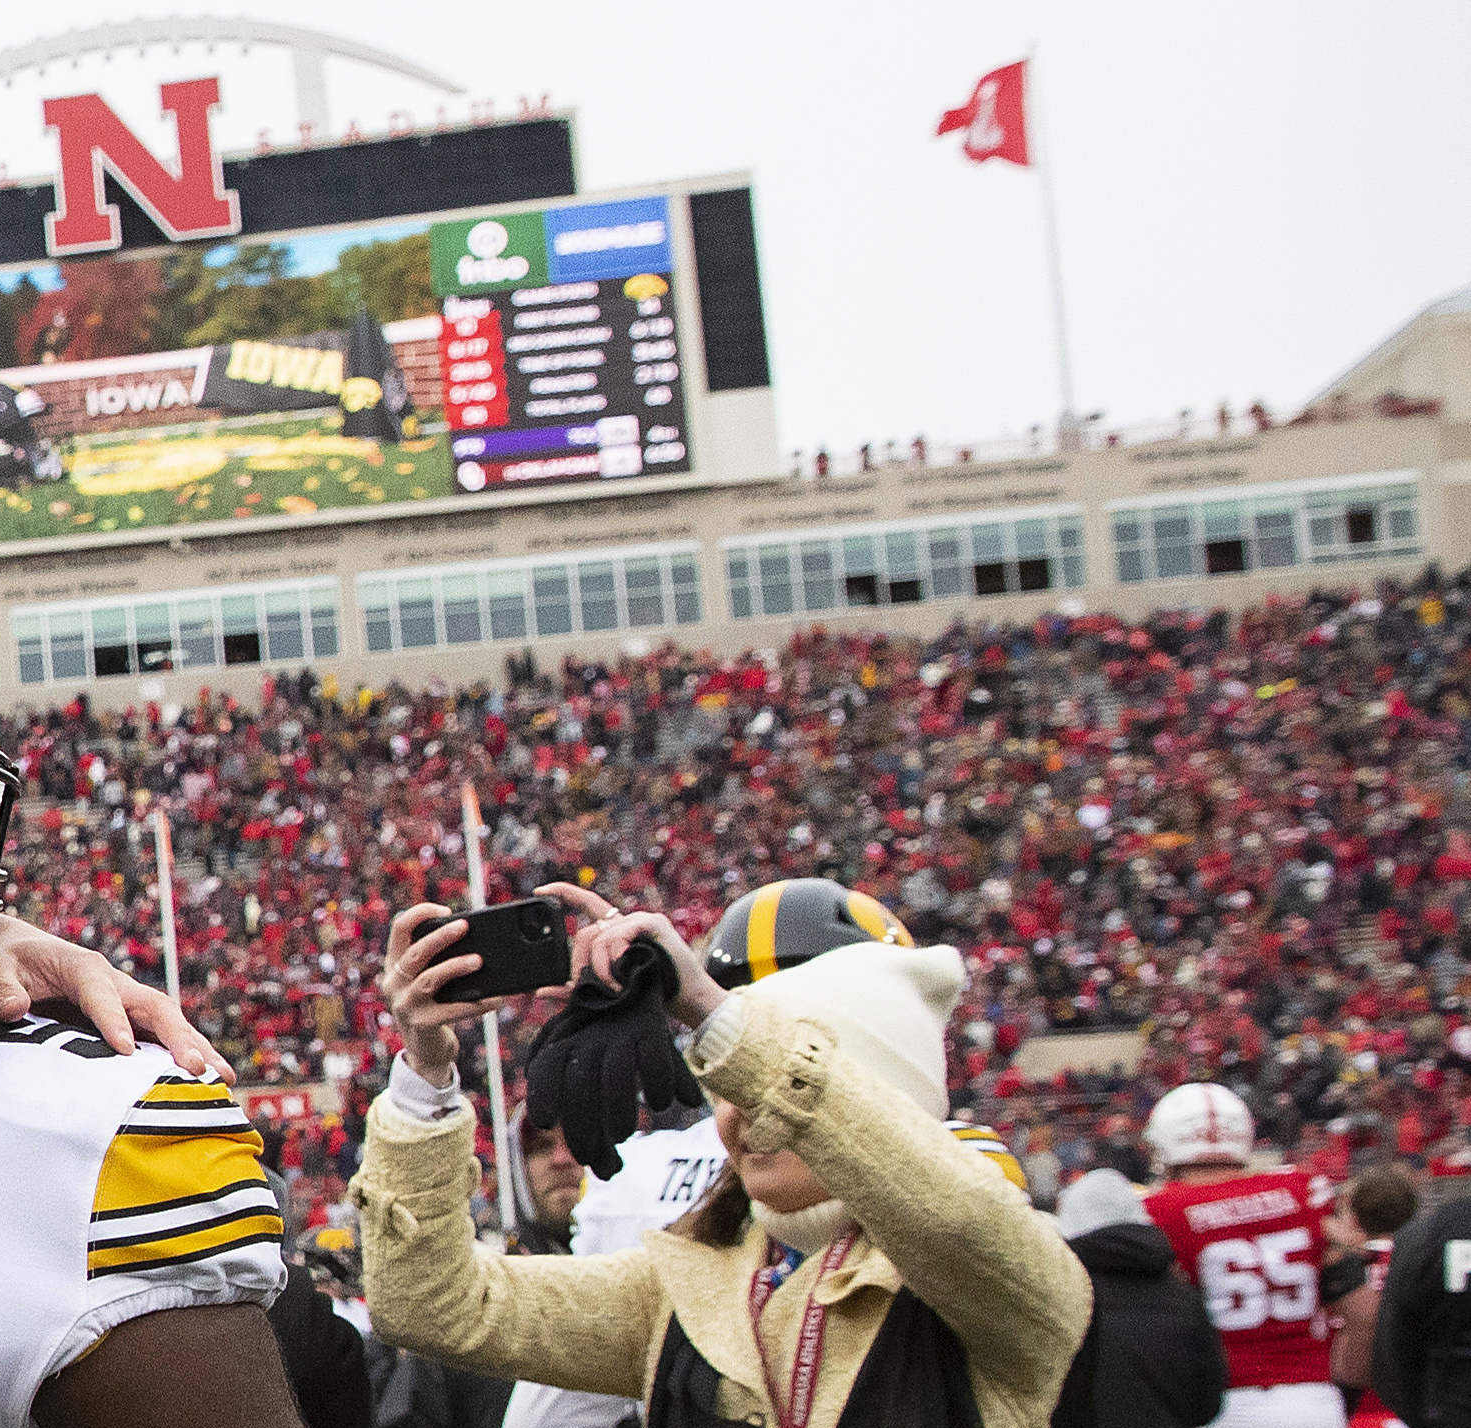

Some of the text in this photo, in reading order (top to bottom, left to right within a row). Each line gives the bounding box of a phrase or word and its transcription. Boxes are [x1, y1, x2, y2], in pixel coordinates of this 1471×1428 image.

[42, 76, 240, 256] N
[85, 380, 190, 416] IOWA
[226, 340, 345, 395] IOWA
[1198, 1226, 1323, 1332] 65
